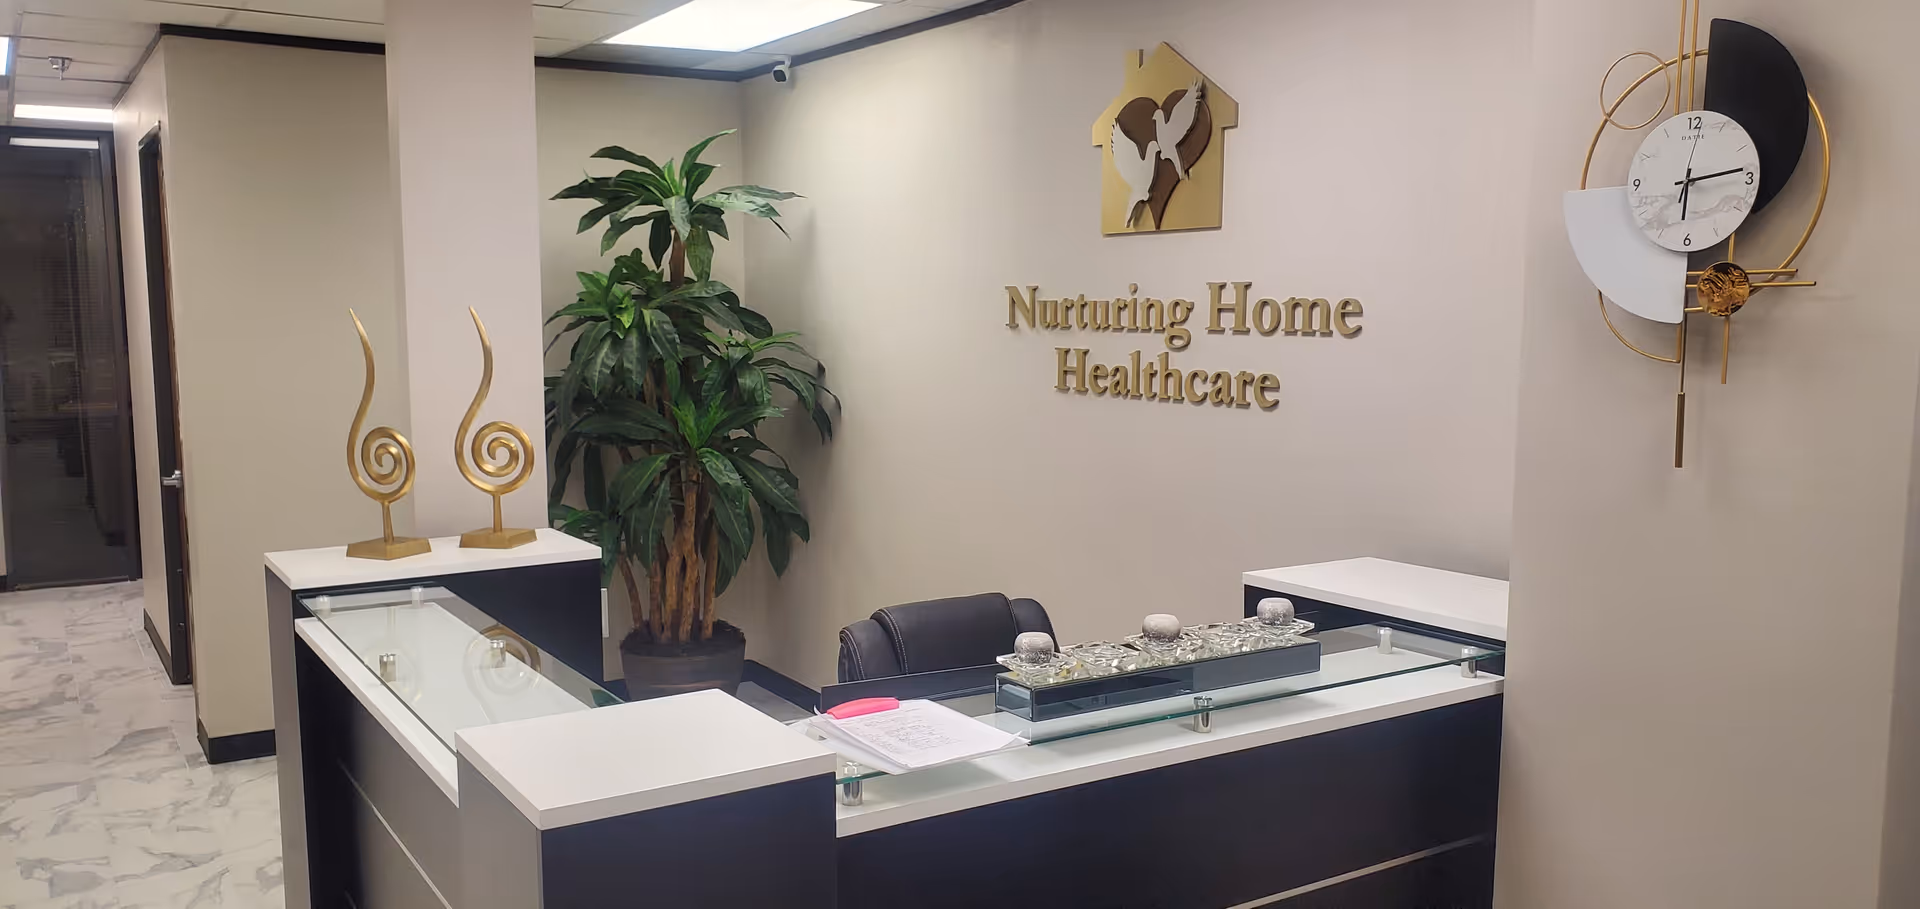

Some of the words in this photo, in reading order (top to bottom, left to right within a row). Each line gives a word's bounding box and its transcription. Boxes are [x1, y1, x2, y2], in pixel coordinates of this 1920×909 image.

[1687, 116, 1702, 130] 12
[1633, 178, 1641, 191] 9
[1745, 171, 1754, 185] 3
[1683, 233, 1692, 247] 6
[1004, 283, 1194, 350] Nurturing
[1205, 280, 1364, 338] Home
[1054, 347, 1281, 411] Healthcare
